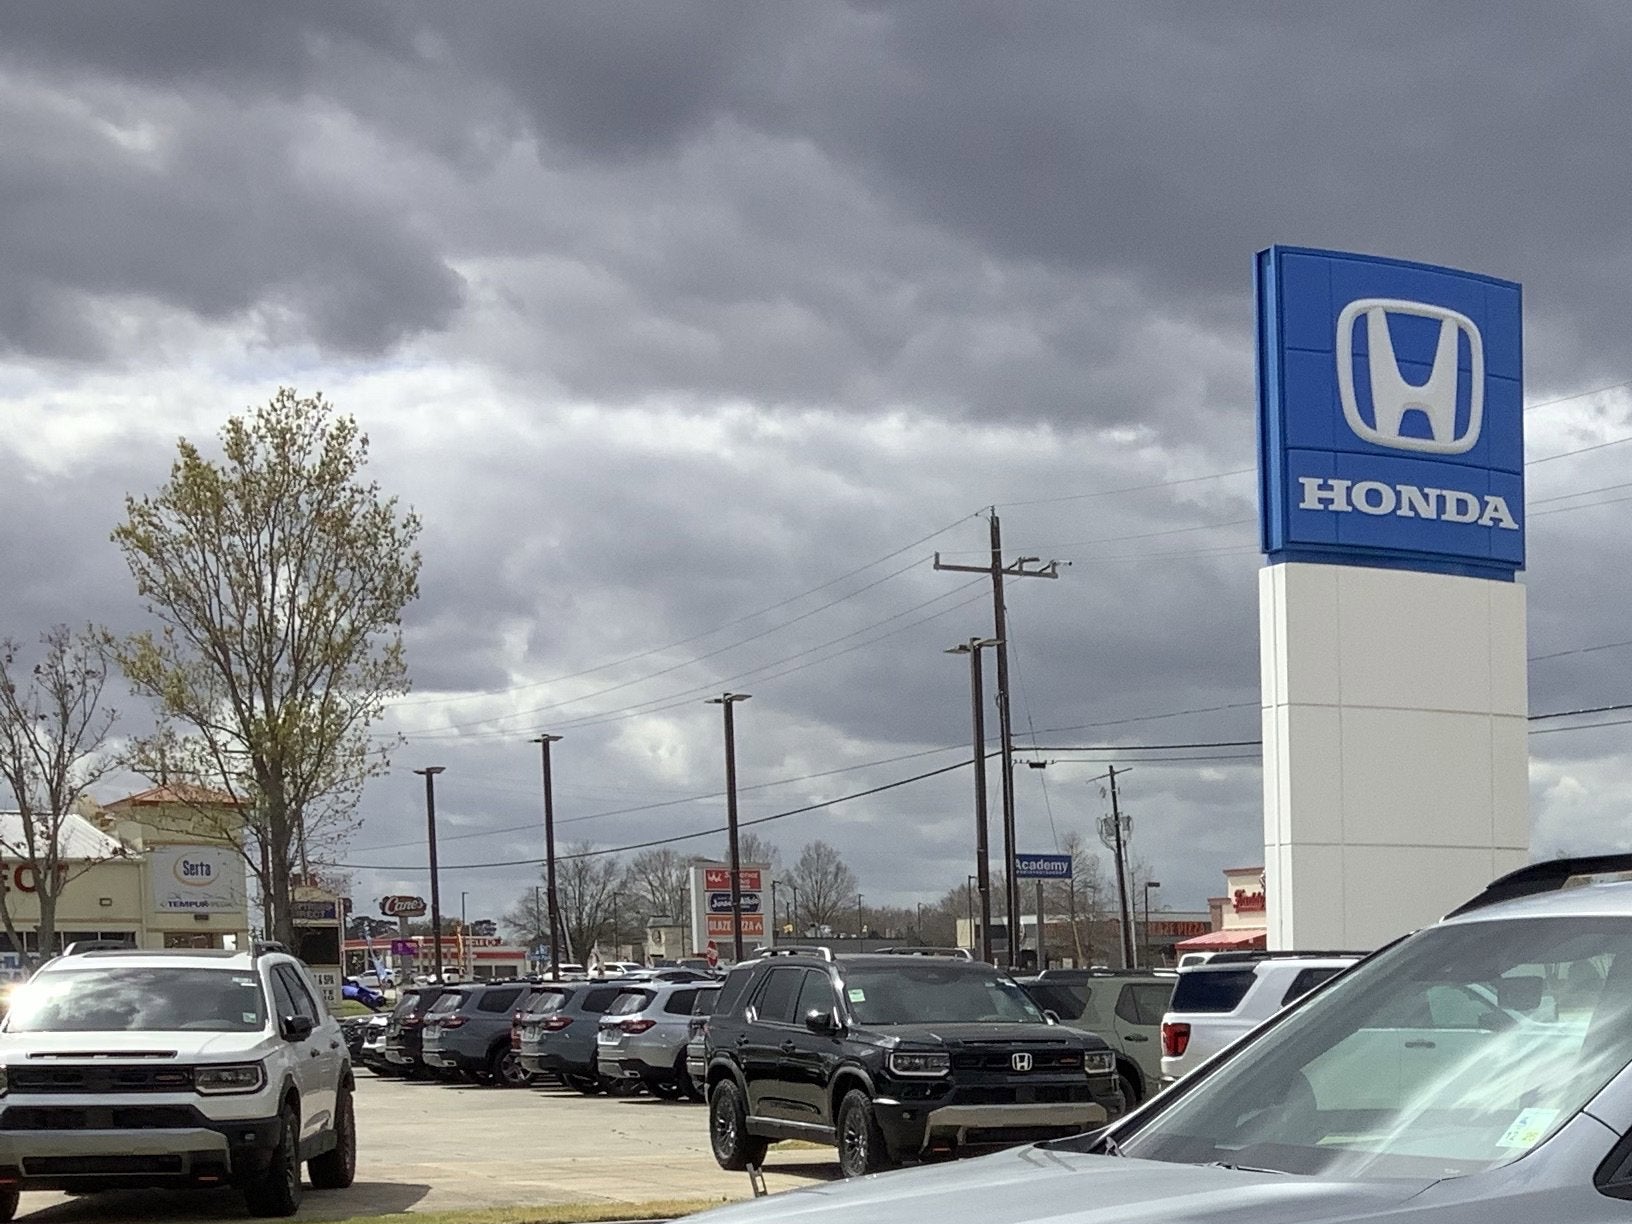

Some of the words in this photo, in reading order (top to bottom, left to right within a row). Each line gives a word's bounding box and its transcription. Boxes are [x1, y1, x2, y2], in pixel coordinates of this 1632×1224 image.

[1298, 477, 1519, 530] HONDA
[182, 860, 211, 876] Serta
[1016, 858, 1069, 874] Academy
